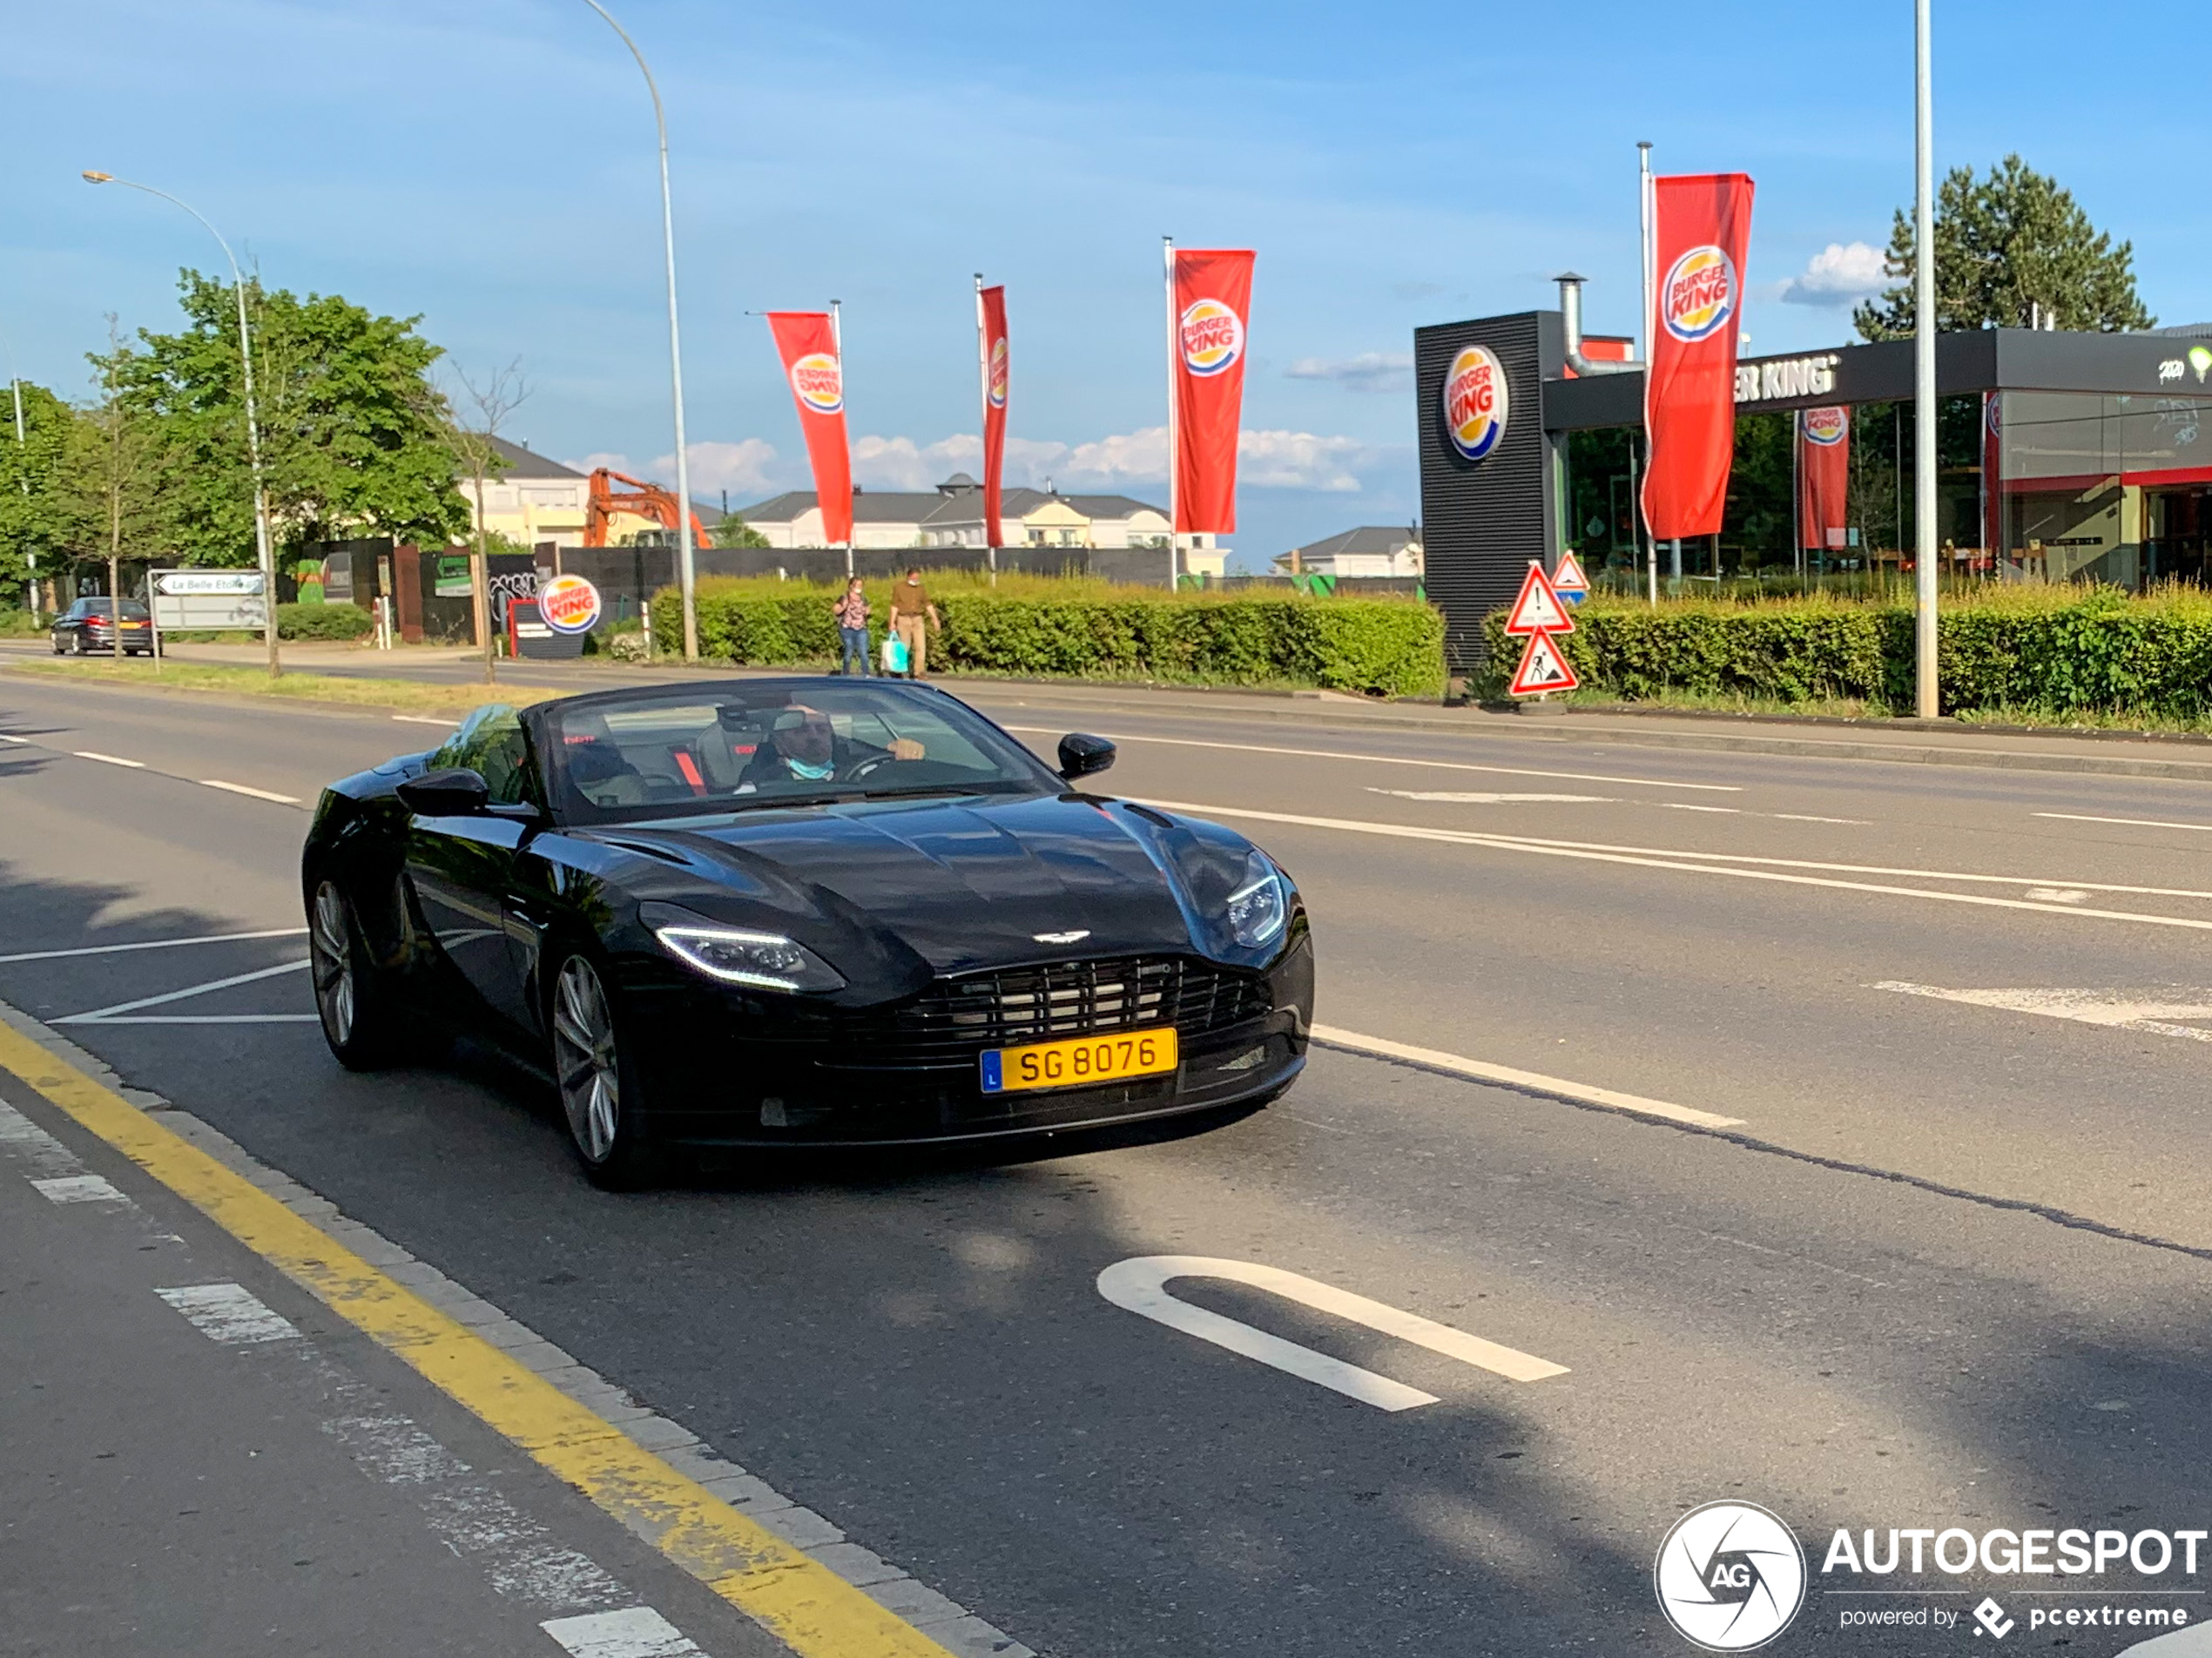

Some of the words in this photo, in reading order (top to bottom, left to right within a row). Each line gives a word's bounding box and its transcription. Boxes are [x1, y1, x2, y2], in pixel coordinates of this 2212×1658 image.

[1672, 263, 1726, 300] BURGER
[1672, 279, 1727, 321] KING
[1184, 316, 1232, 338] BURGER
[1185, 328, 1234, 354] KING
[1762, 357, 1833, 400] KING
[1450, 384, 1493, 435] KING
[172, 579, 184, 590] La
[187, 579, 212, 590] Belle
[547, 586, 590, 607] BURGER
[550, 596, 594, 621] KING
[1021, 1050, 1062, 1082] SG
[1073, 1038, 1156, 1076] 8076
[988, 1074, 996, 1085] L
